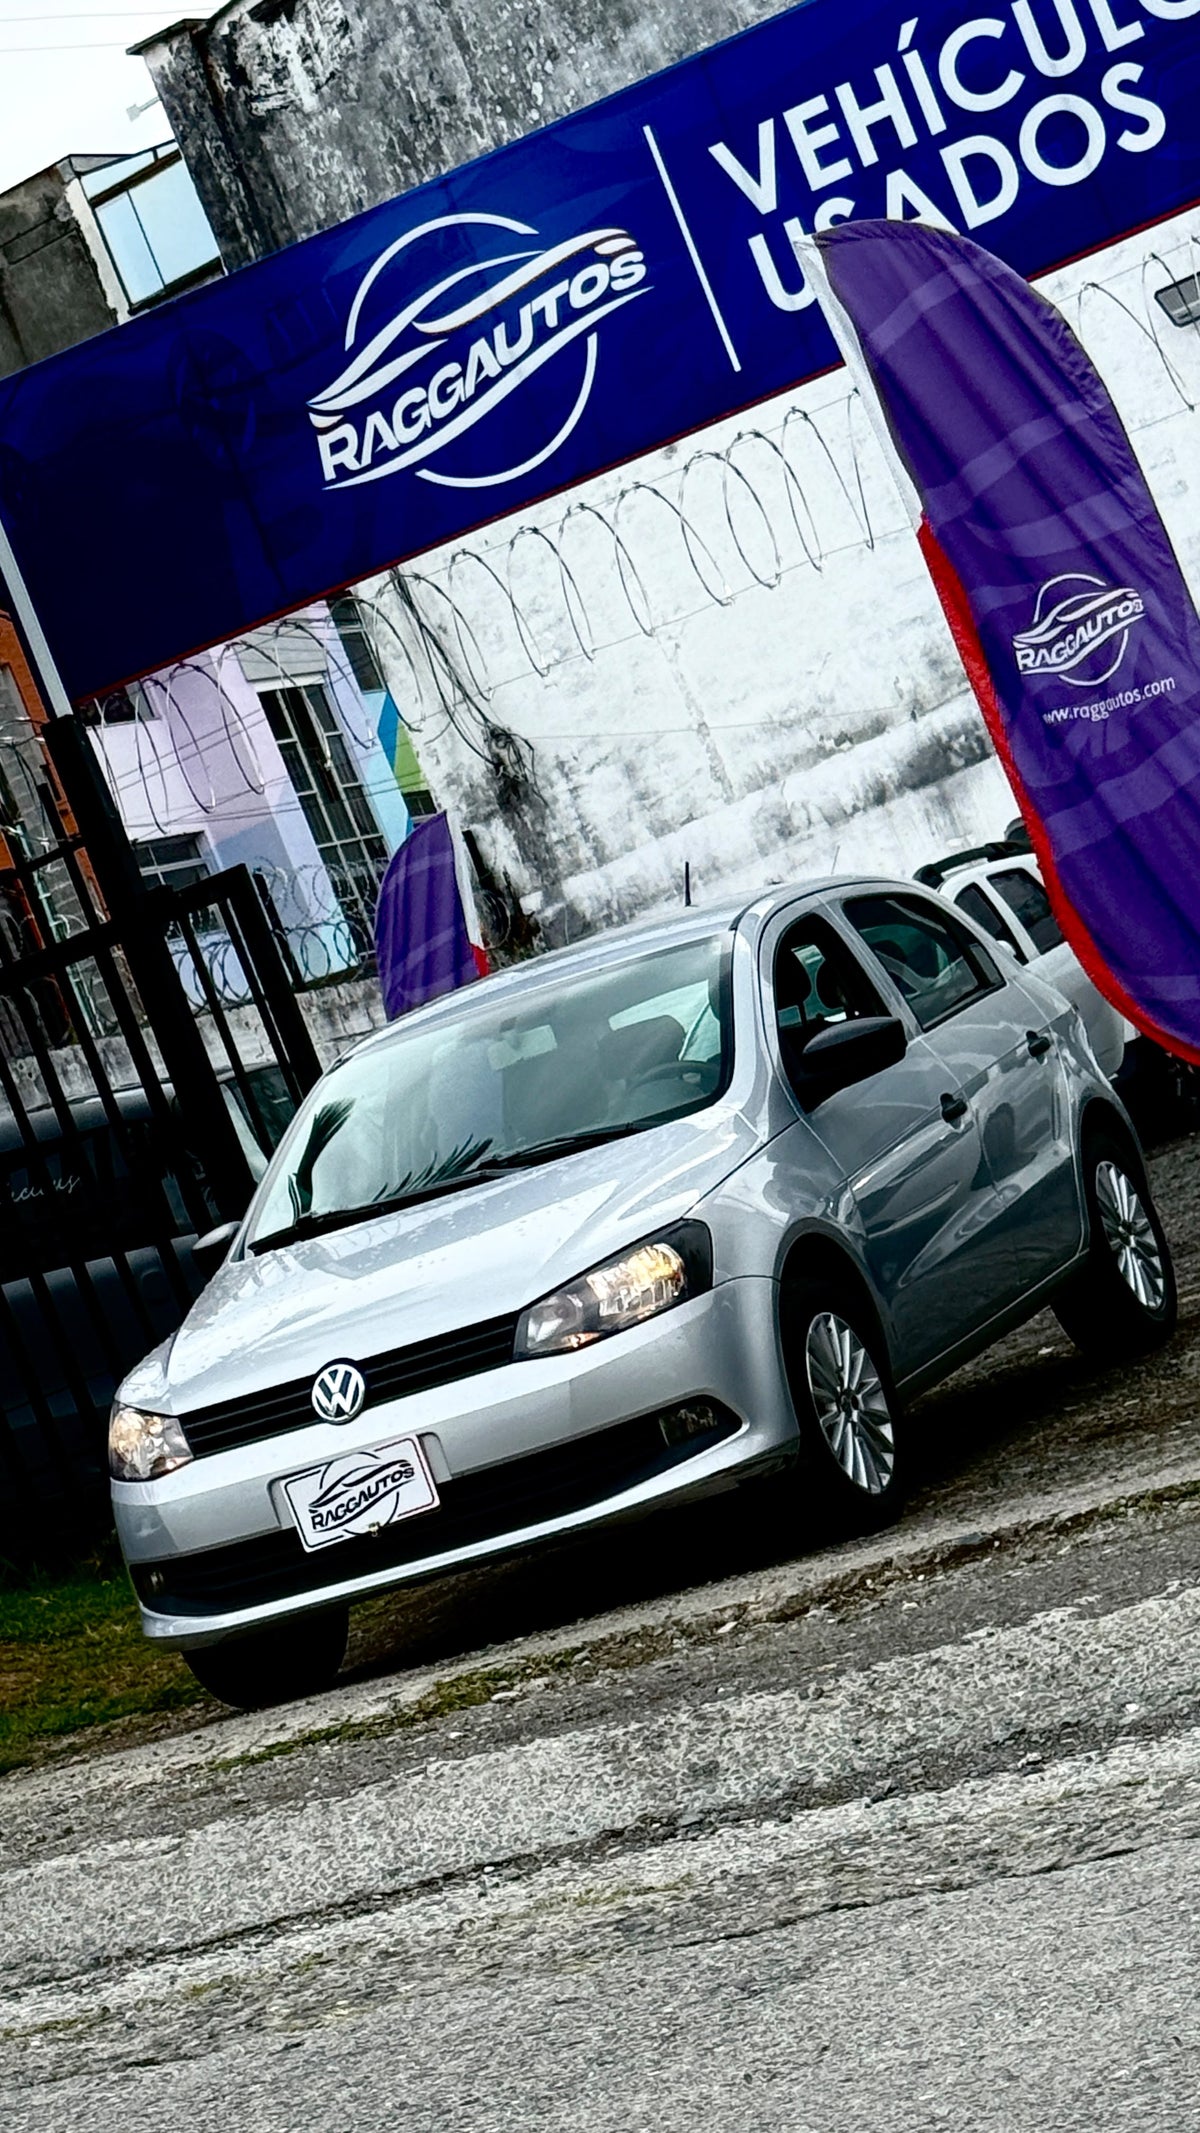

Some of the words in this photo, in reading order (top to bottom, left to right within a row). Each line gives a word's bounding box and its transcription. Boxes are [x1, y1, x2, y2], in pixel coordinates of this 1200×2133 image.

[708, 0, 1200, 215] VEHÍCUL
[316, 251, 646, 481] RAGGAUTOS
[1015, 599, 1144, 670] RAGGAUTOS
[313, 1364, 364, 1421] VW
[311, 1467, 415, 1530] RAGGAUTOS
